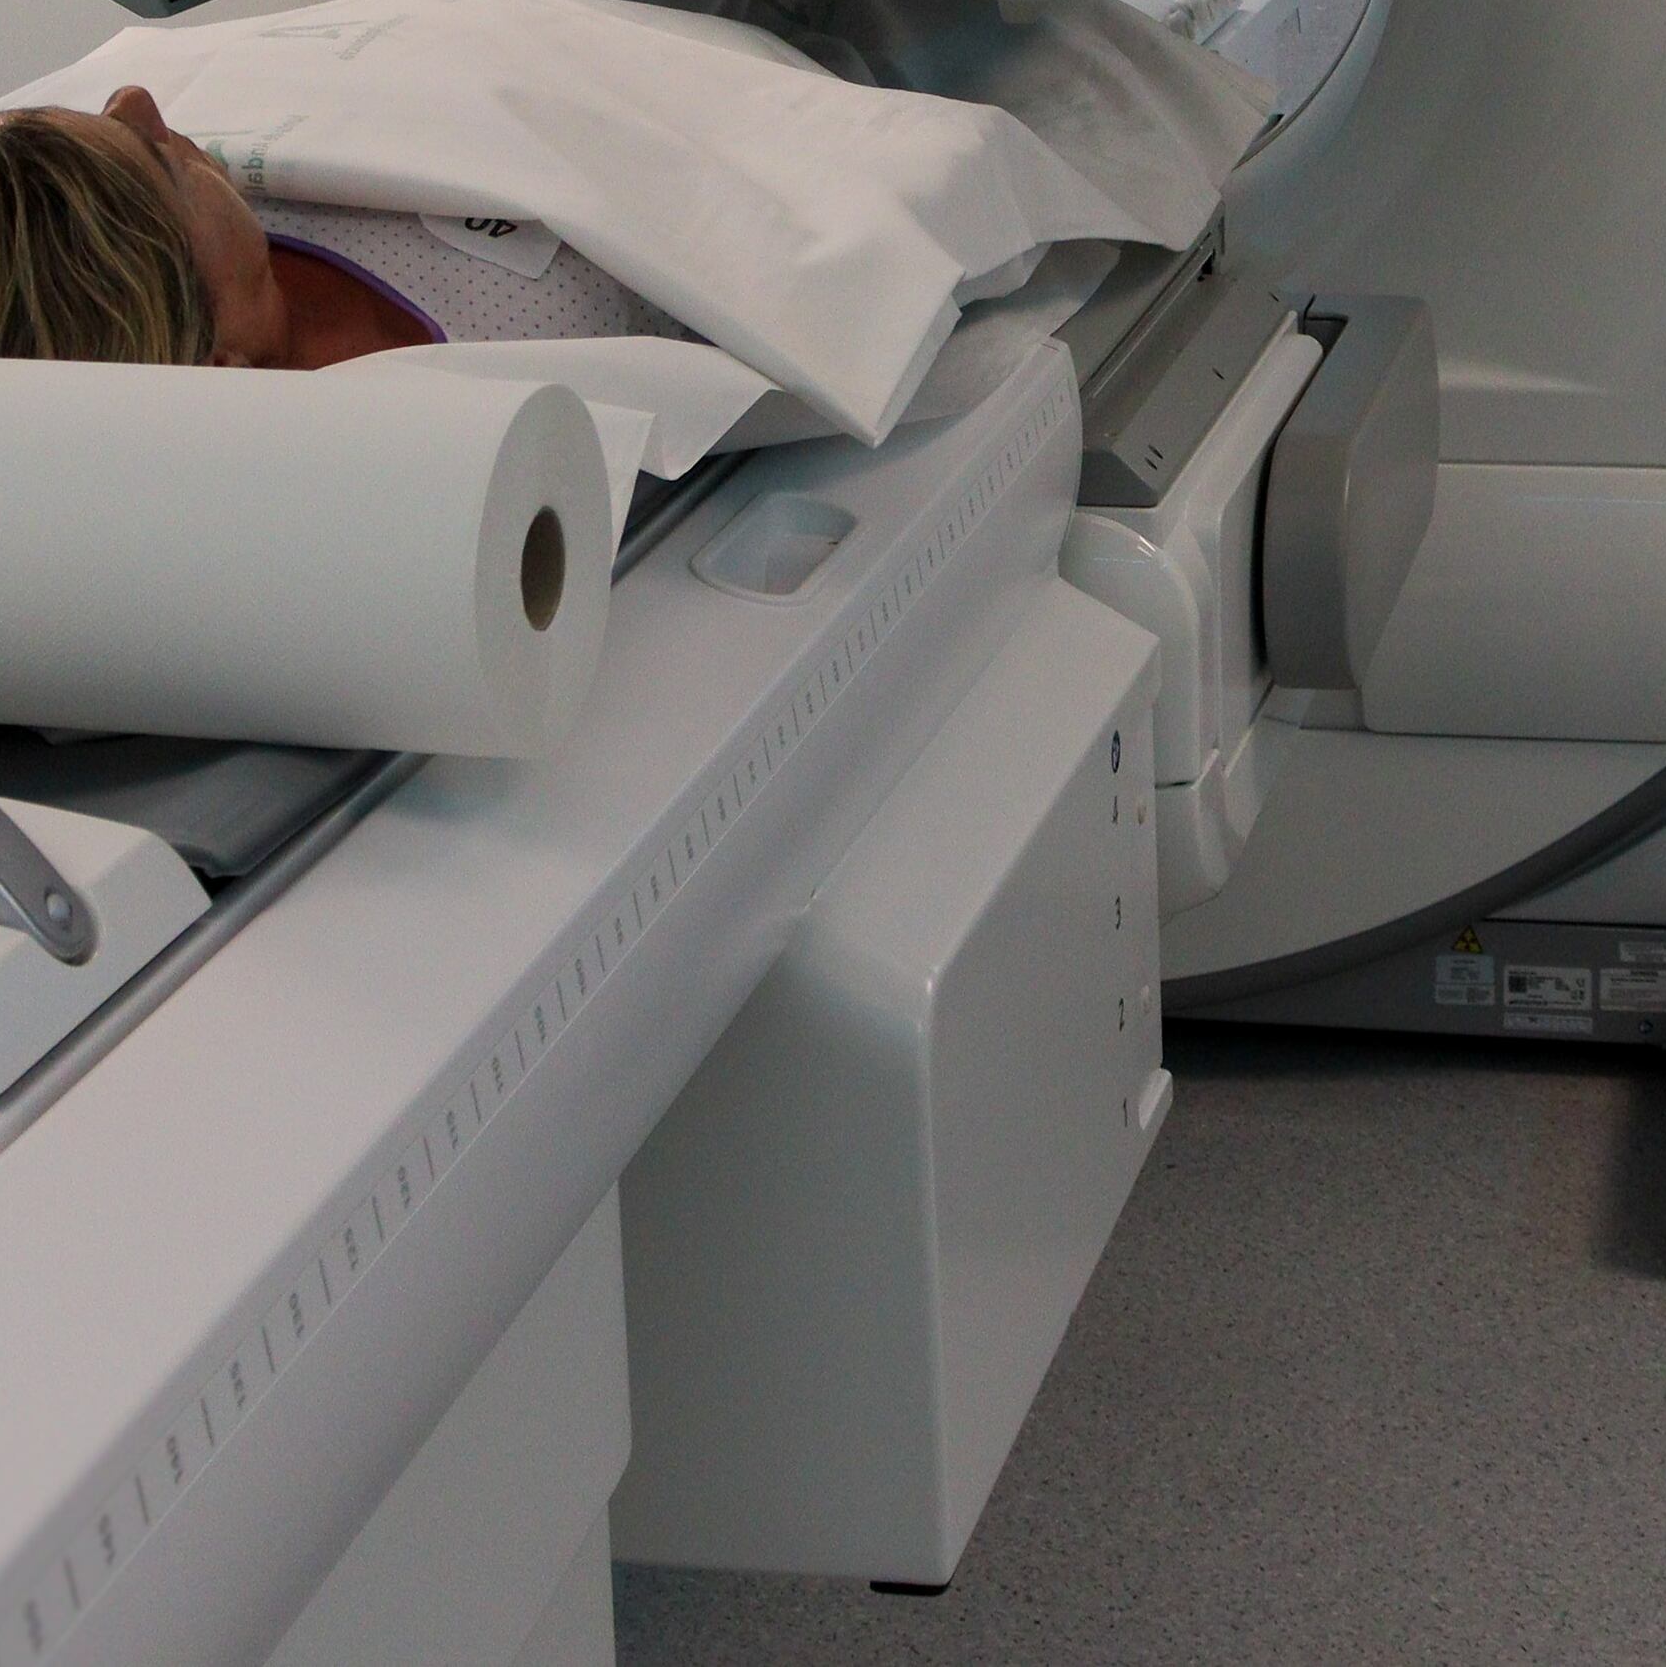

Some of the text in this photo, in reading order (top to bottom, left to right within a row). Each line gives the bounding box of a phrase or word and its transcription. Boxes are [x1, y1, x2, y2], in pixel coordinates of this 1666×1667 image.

[1114, 895, 1121, 931] 3
[1117, 996, 1125, 1032] 2
[1122, 1096, 1129, 1128] 1
